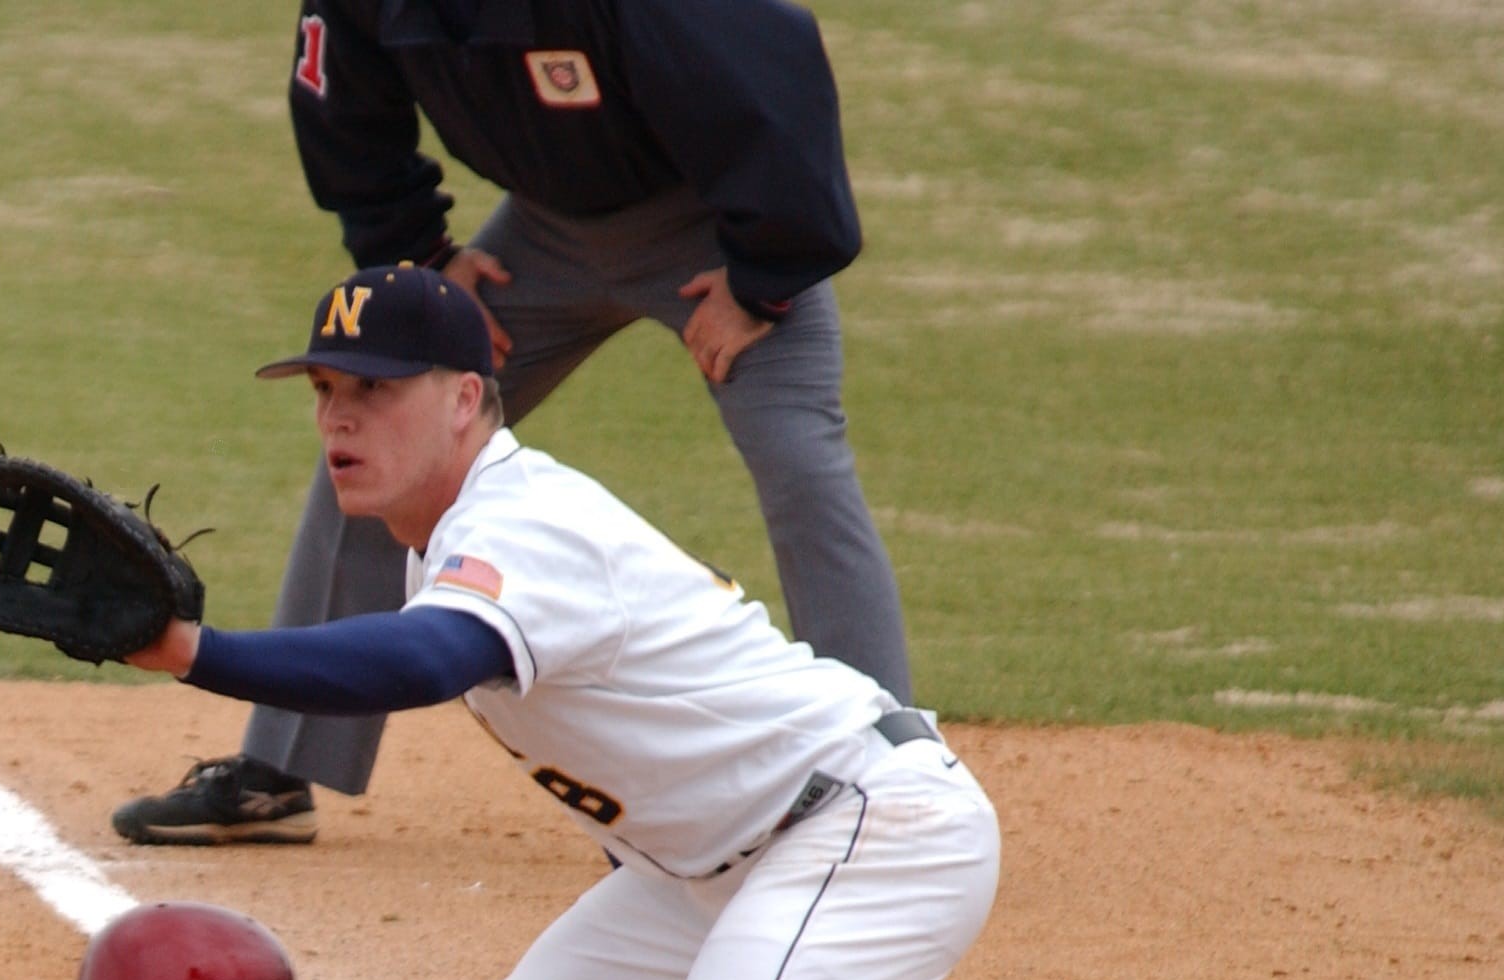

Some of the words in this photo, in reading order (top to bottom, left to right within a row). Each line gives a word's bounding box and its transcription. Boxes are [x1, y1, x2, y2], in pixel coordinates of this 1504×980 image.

[297, 14, 326, 97] 1
[321, 285, 372, 337] N
[529, 765, 625, 826] 8
